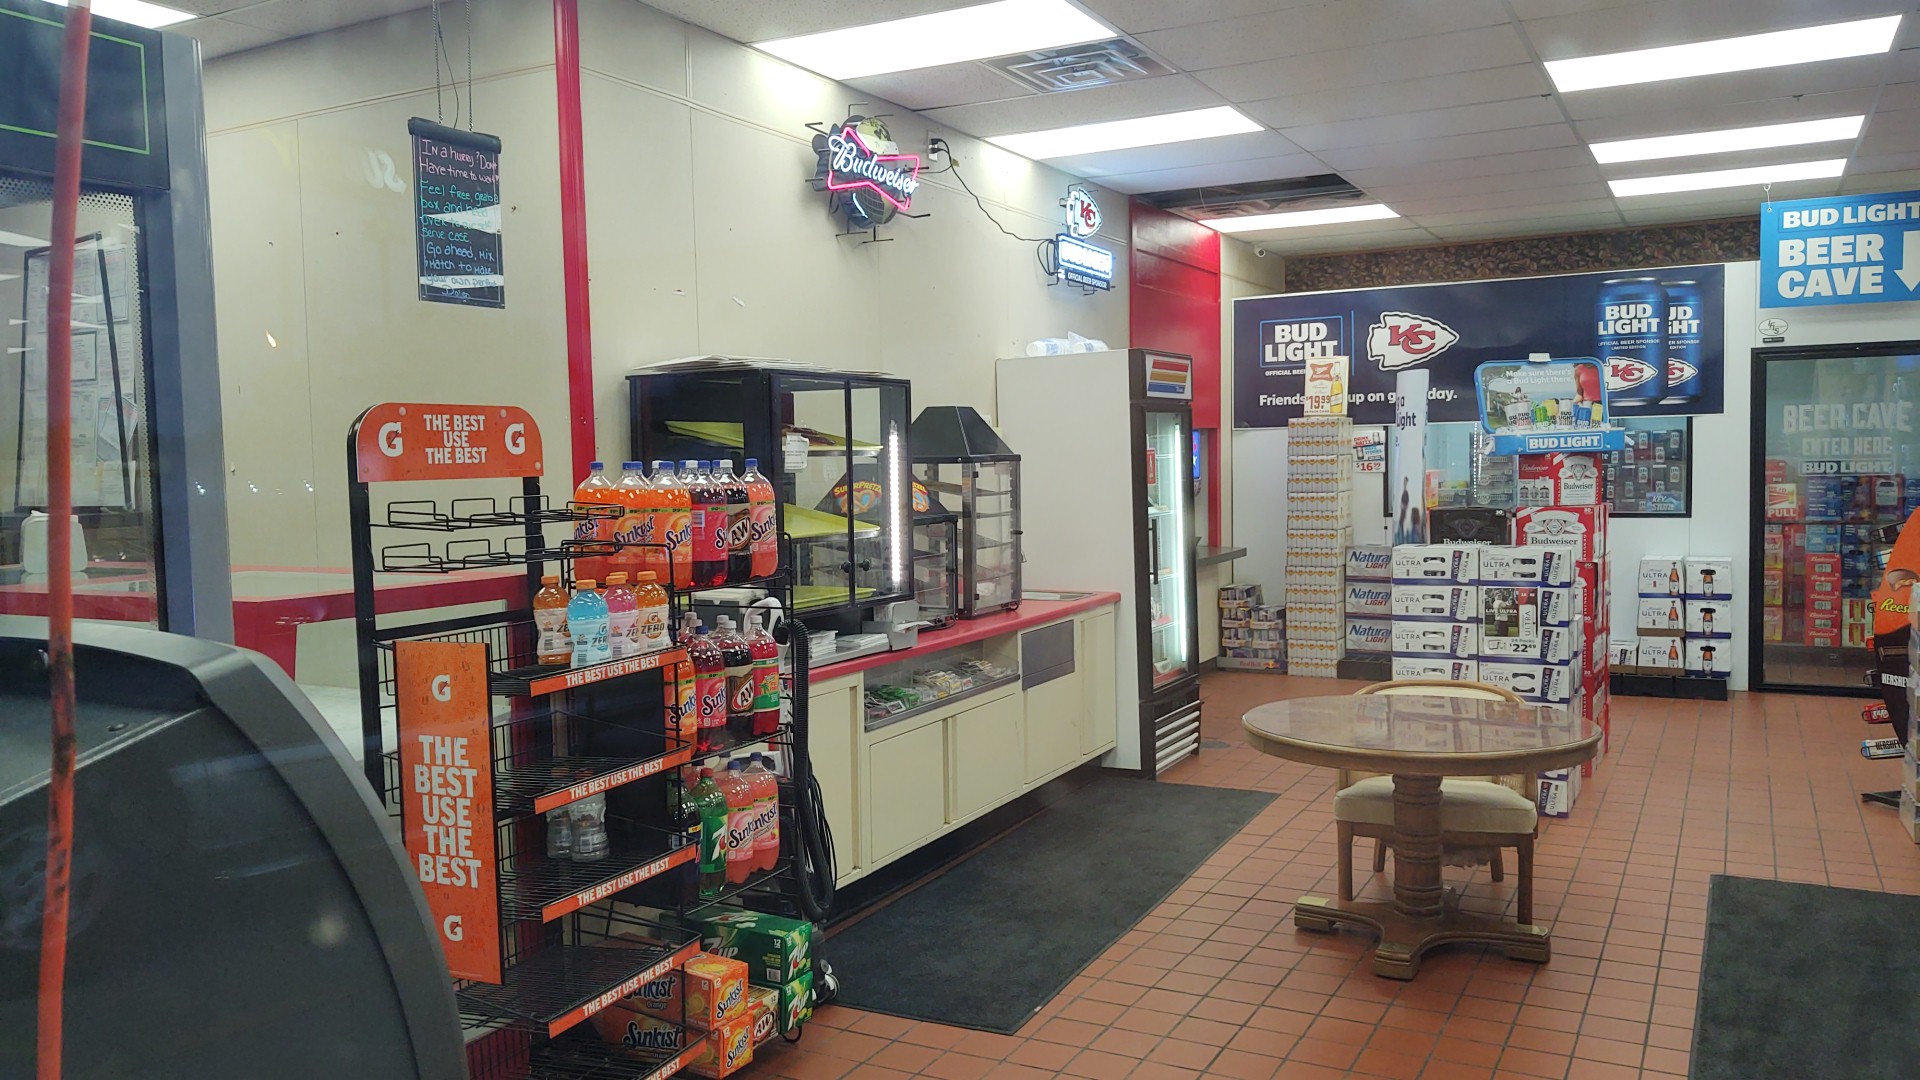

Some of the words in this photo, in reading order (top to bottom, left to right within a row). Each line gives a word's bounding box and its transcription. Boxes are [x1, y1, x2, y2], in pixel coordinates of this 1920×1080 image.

[420, 156, 446, 176] Have
[447, 165, 469, 178] time
[828, 135, 919, 195] Budweiser
[421, 180, 445, 197] Feel
[420, 196, 440, 210] box
[444, 202, 462, 213] and
[1080, 200, 1096, 228] KC
[1783, 207, 1839, 229] BUD
[1843, 202, 1920, 225] LIGHT
[427, 242, 442, 258] Go
[1778, 233, 1885, 267] BEER
[458, 262, 472, 271] to
[1777, 265, 1884, 299] CAVE
[1605, 304, 1653, 320] BUD
[1274, 322, 1328, 344] BUD
[1598, 318, 1661, 335] LIGHT
[1389, 324, 1436, 355] KC
[1264, 340, 1338, 362] LIGHT
[1264, 369, 1291, 377] OFFICIAL
[1505, 370, 1528, 378] Make
[1546, 368, 1572, 376] there's
[1530, 376, 1550, 384] Light
[1611, 363, 1644, 382] KC
[1259, 393, 1306, 406] Friends
[1367, 391, 1385, 403] on
[423, 414, 450, 431] THE
[453, 414, 486, 432] BEST
[1783, 404, 1848, 434] BEER
[1852, 401, 1914, 432] CAVE
[378, 422, 404, 457] G
[443, 431, 470, 448] USE
[504, 423, 526, 455] G
[1529, 438, 1559, 450] BUD
[1560, 436, 1600, 448] LIGHT
[1802, 437, 1850, 456] ENTER
[1853, 437, 1893, 455] HERE
[425, 447, 453, 465] THE
[455, 447, 488, 464] BEST
[1521, 464, 1549, 473] Budweiser
[1802, 461, 1838, 475] BUD
[1840, 460, 1893, 474] LIGHT
[1563, 482, 1594, 490] Budweiser
[1767, 508, 1797, 518] PULL
[1531, 536, 1578, 545] Budweiser
[641, 622, 665, 634] ZERO
[565, 673, 584, 687] THE
[584, 667, 606, 683] BEST
[607, 663, 624, 677] USE
[623, 659, 641, 673] THE
[640, 655, 660, 669] BEST
[431, 674, 451, 702] G
[418, 735, 469, 768] THE
[414, 764, 478, 798] BEST
[569, 785, 588, 800] THE
[588, 779, 611, 794] BEST
[611, 771, 628, 786] USE
[627, 766, 644, 780] THE
[644, 758, 664, 774] BEST
[421, 795, 473, 829] USE
[422, 825, 474, 858] THE
[418, 853, 482, 889] BEST
[577, 889, 596, 906] THE
[595, 879, 618, 898] BEST
[617, 874, 634, 889] USE
[633, 865, 651, 882] THE
[650, 857, 670, 875] BEST
[443, 915, 463, 942] G
[773, 938, 782, 946] 12
[582, 998, 601, 1017] THE
[601, 986, 623, 1006] BEST
[622, 977, 640, 994] USE
[638, 969, 655, 985] THE
[654, 957, 674, 975] BEST
[647, 1000, 668, 1009] Orange
[716, 979, 744, 1020] Sunkist
[623, 1019, 682, 1050] Sunkist
[726, 1025, 751, 1068] Sunkist
[660, 1057, 681, 1078] BEST
